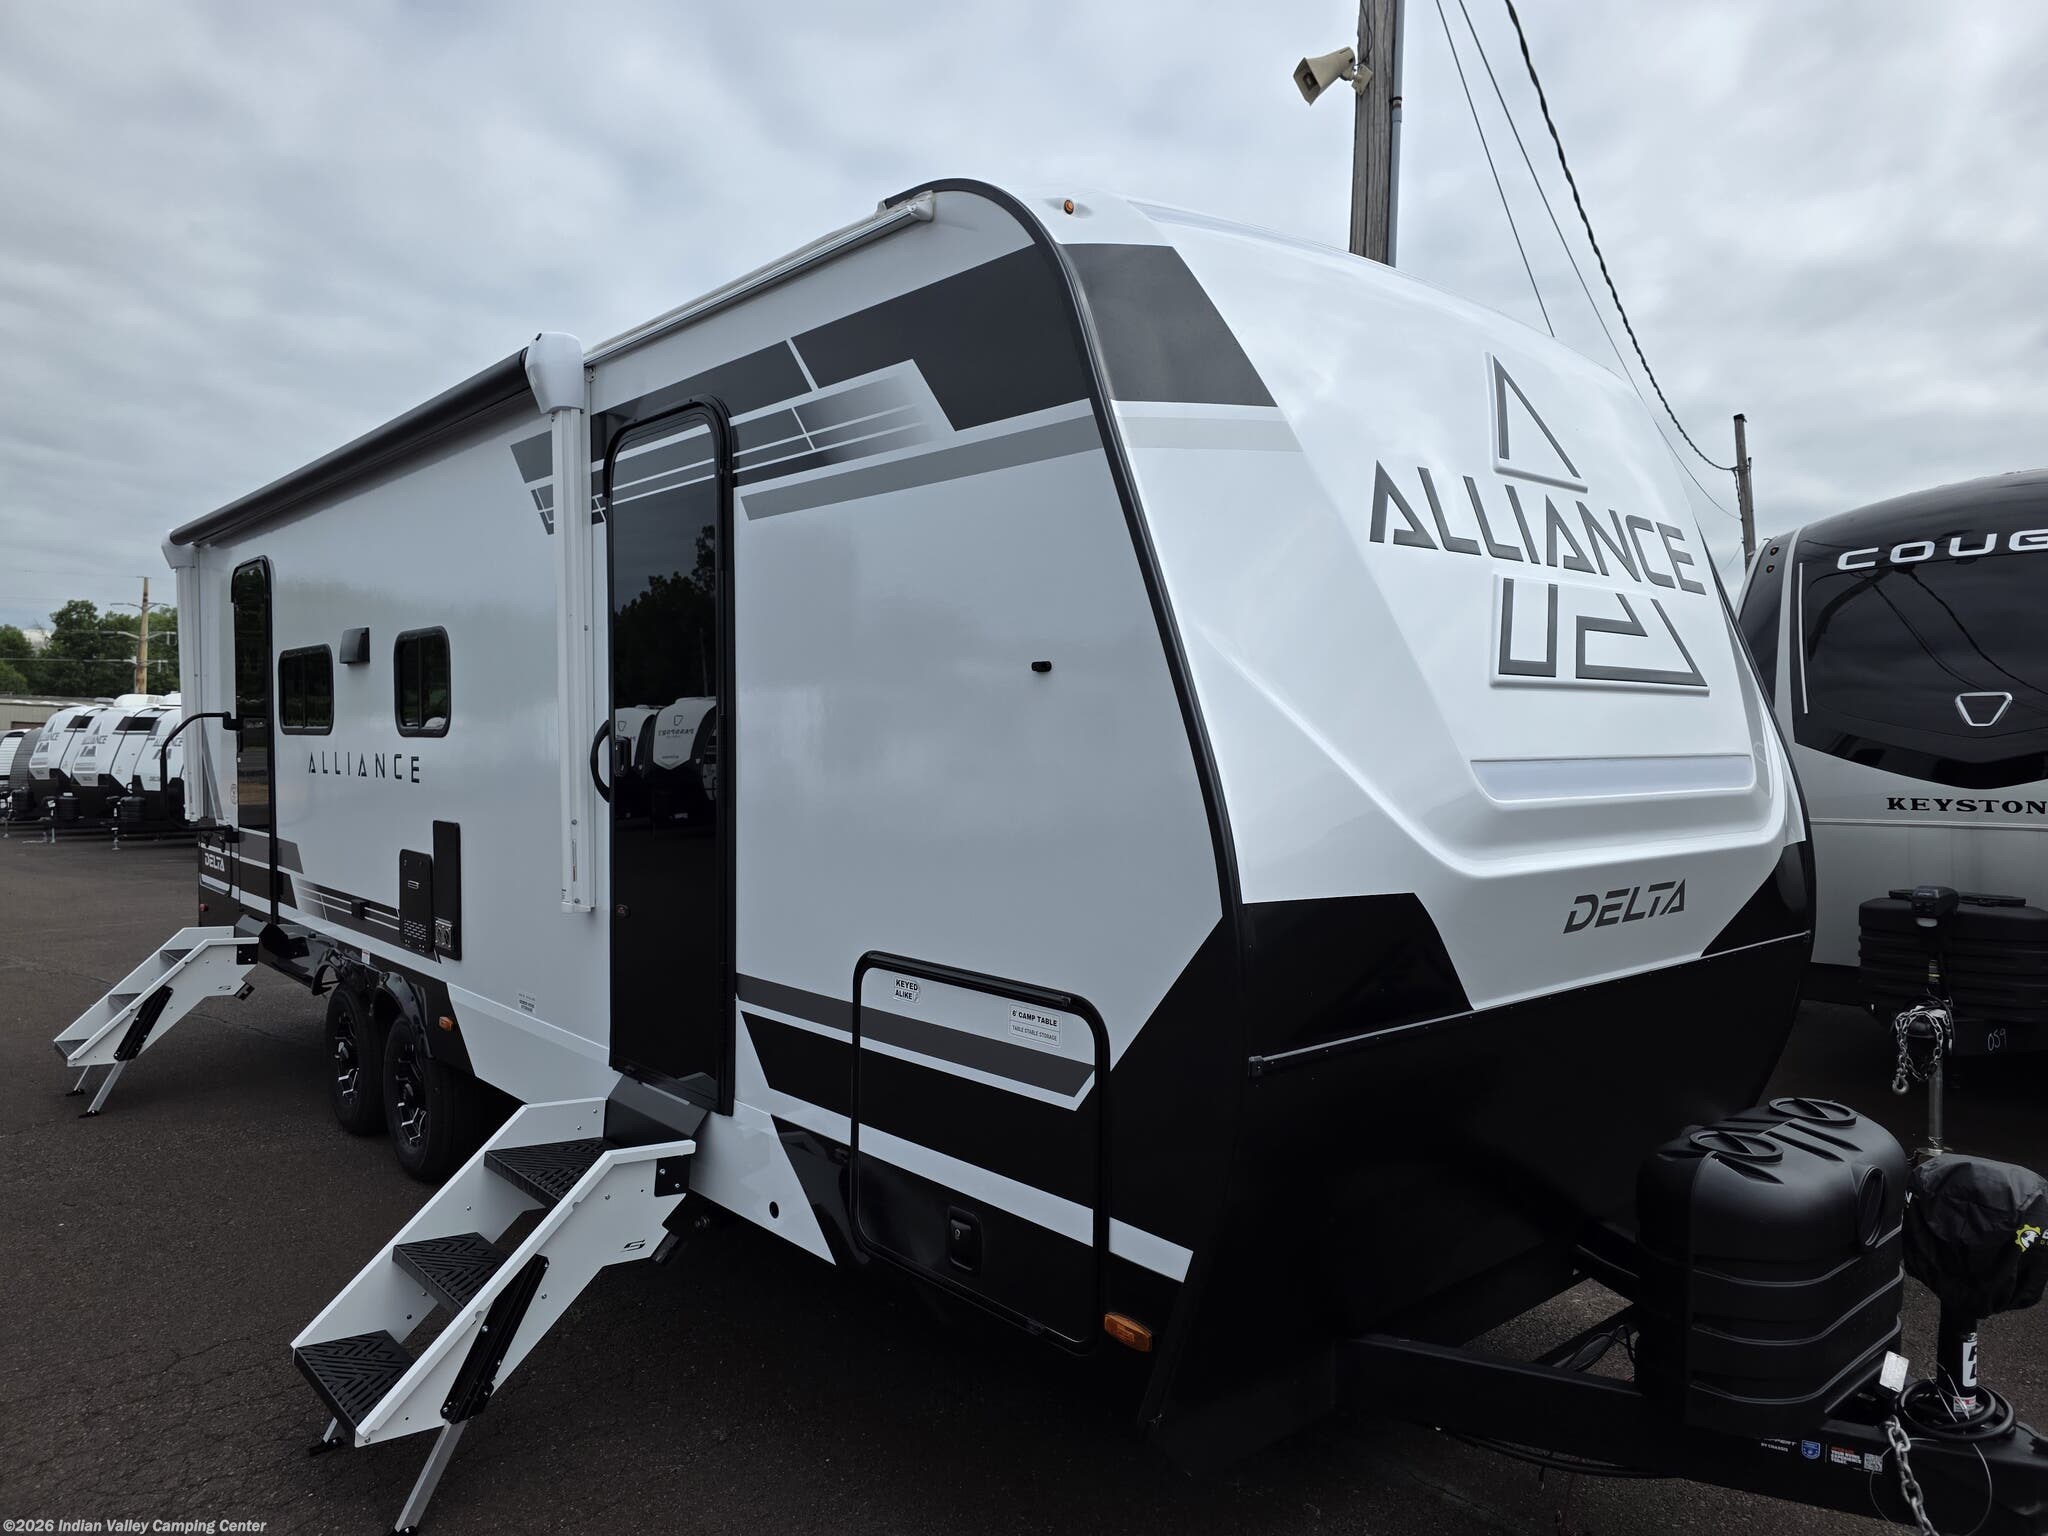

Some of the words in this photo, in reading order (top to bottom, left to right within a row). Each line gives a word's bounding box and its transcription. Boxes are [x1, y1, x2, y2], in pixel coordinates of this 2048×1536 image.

[1369, 459, 1707, 596] ALLIANCE
[1836, 528, 2048, 571] COUG
[308, 750, 420, 784] ALLIANCE
[1885, 797, 2048, 815] KEYSTON
[204, 852, 226, 872] DELTA
[1562, 878, 1687, 935] DELTA
[895, 979, 919, 991] KEYED
[895, 989, 913, 1000] ALIKE
[1018, 1011, 1036, 1022] CAMP
[1036, 1015, 1058, 1027] TABLE
